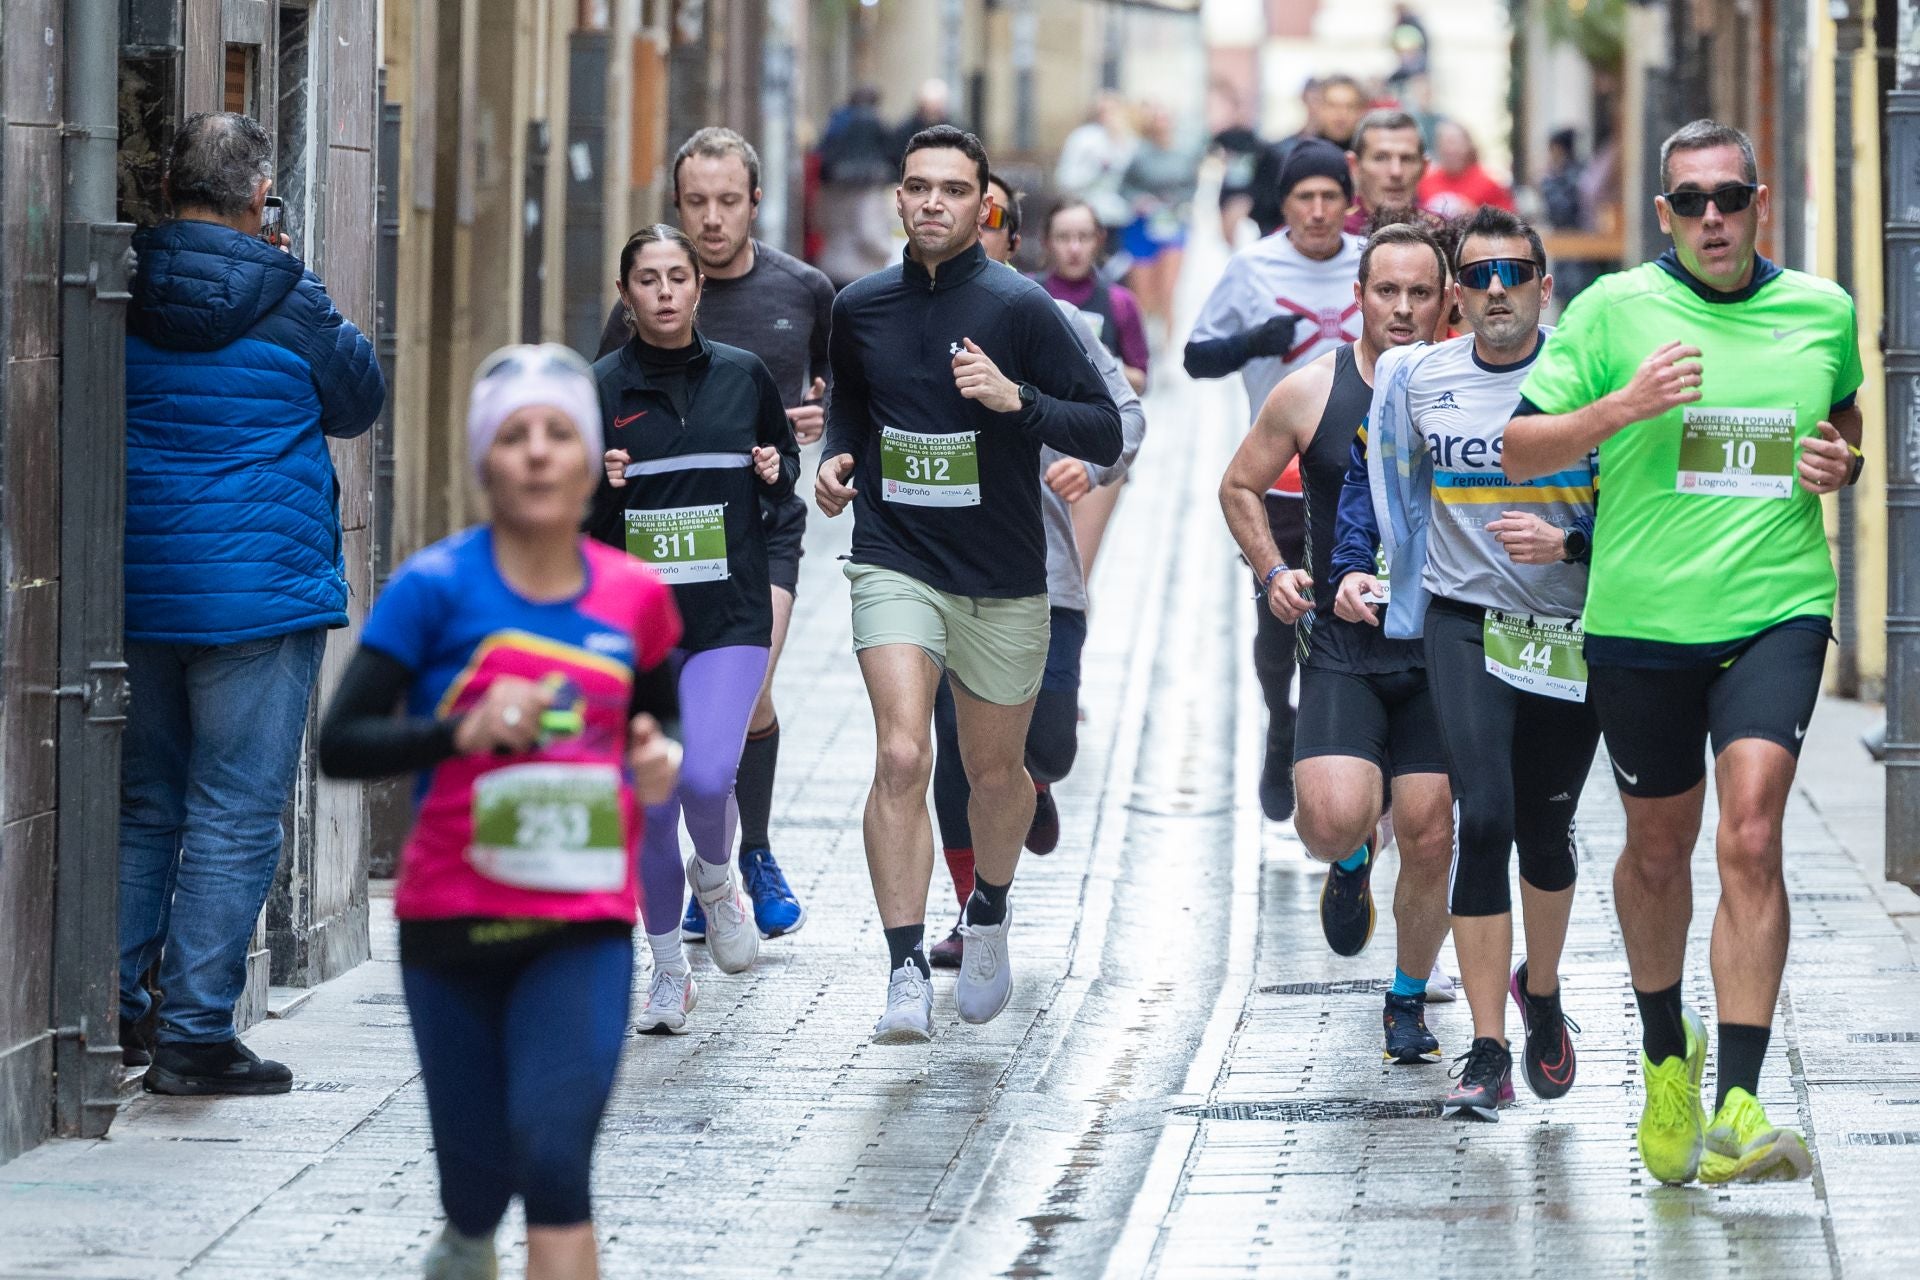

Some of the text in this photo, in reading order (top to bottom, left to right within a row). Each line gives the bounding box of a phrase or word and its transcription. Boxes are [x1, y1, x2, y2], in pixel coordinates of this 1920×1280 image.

[1688, 415, 1792, 426] CARRERA POPULAR
[1690, 424, 1718, 432] VIRGEN
[1746, 426, 1790, 434] ESPERANZA
[884, 430, 972, 444] CARRERA POPULAR
[886, 439, 908, 448] VIRGEN
[930, 443, 971, 451] ESPERANZA
[1722, 439, 1756, 469] 10
[905, 456, 950, 480] 312
[1453, 474, 1534, 487] renovabs
[1698, 477, 1738, 488] Logroño
[898, 486, 930, 496] Logroño
[628, 508, 720, 521] CARRERA POPULAR
[680, 516, 719, 526] ESPERANZA
[653, 531, 696, 558] 311
[645, 566, 679, 576] ogroño
[1490, 612, 1538, 629] CRREA
[1492, 621, 1520, 632] VIRGEN
[1518, 642, 1552, 672] 44
[1502, 668, 1534, 684] Logroño
